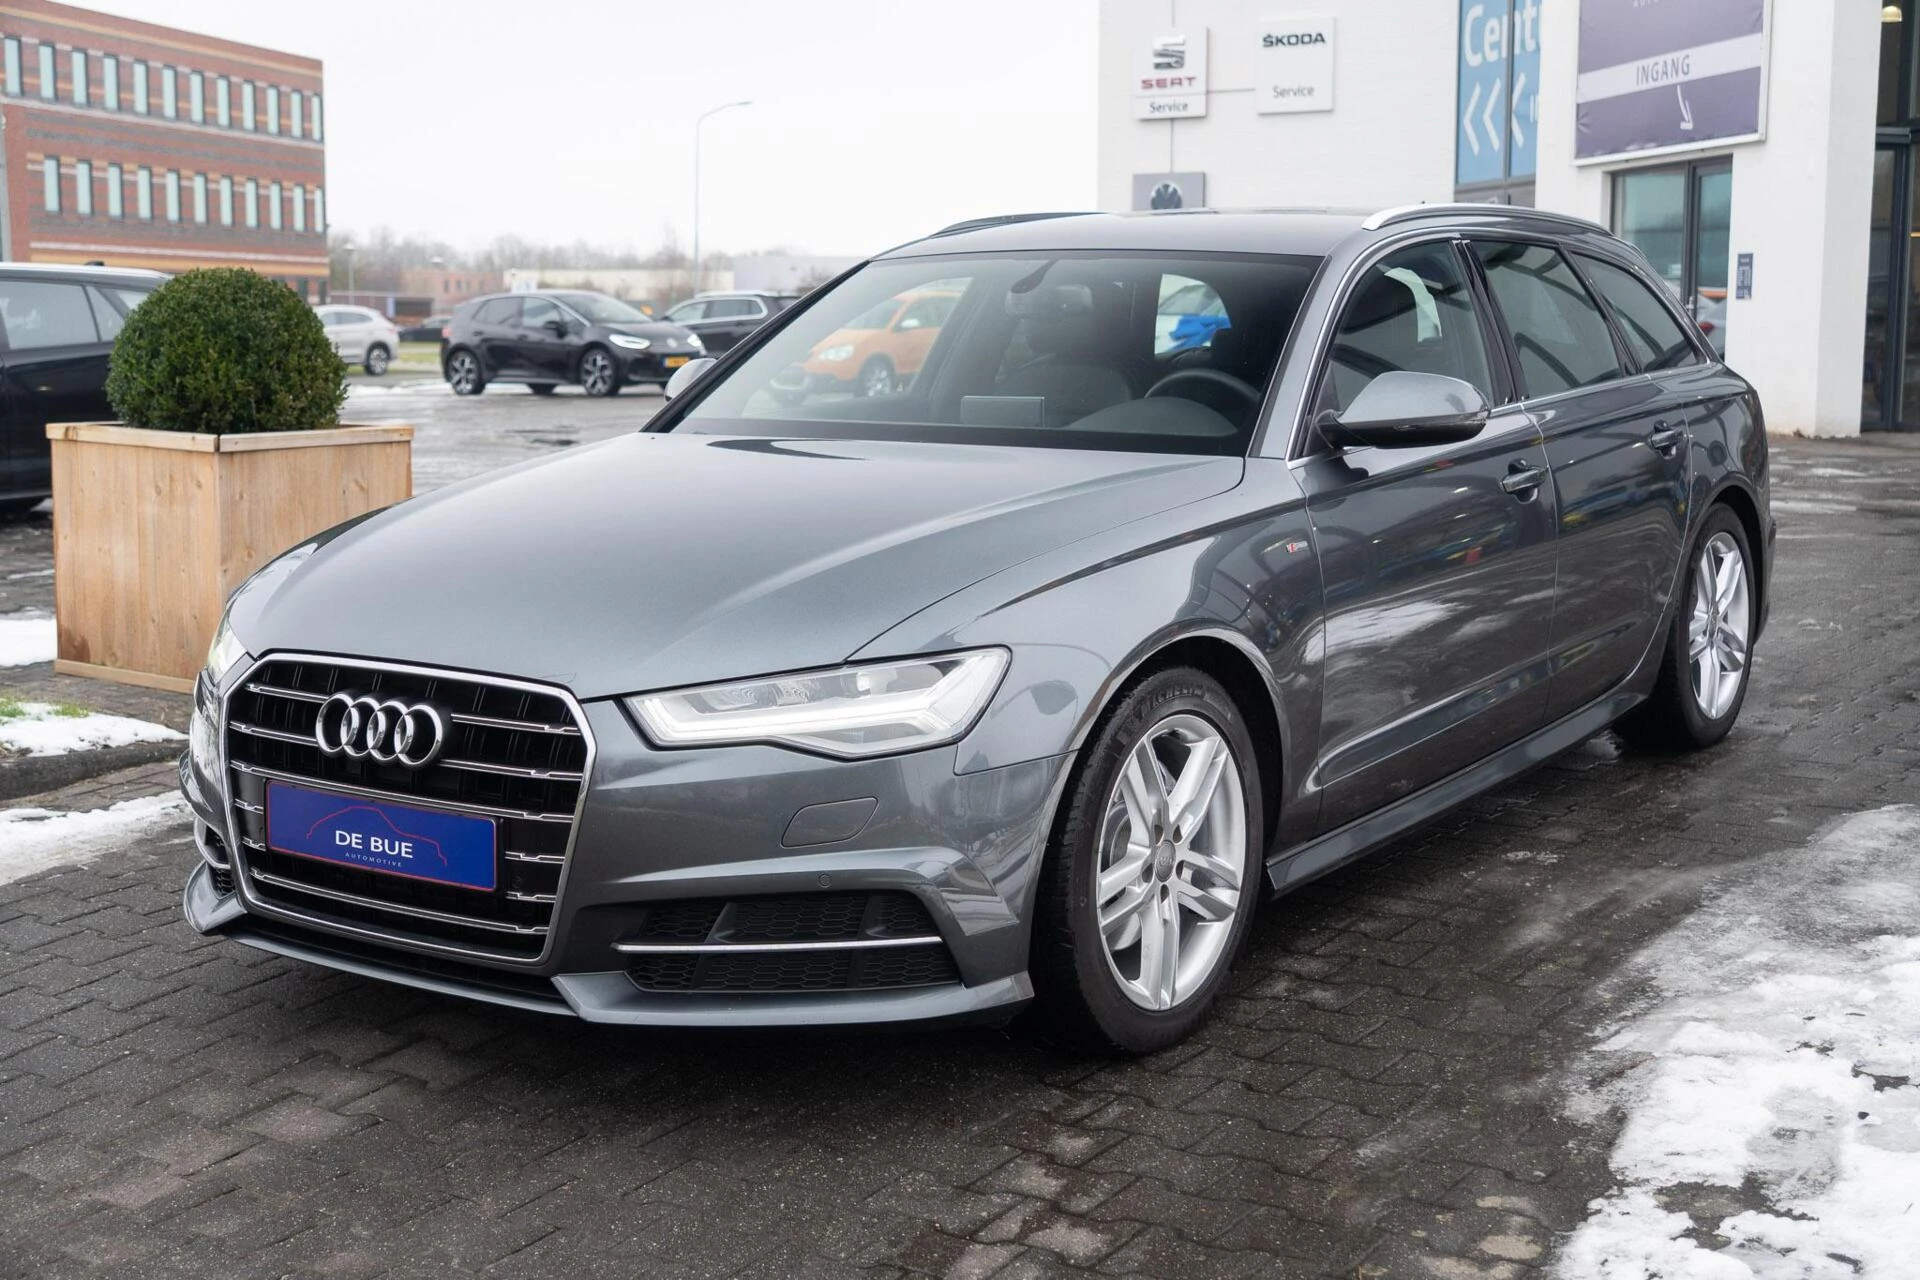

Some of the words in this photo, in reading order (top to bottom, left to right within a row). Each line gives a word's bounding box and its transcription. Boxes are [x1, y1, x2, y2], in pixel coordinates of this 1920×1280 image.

[1263, 32, 1326, 48] ŠKODA
[1464, 0, 1541, 67] Cent
[1635, 53, 1691, 86] INGANG
[1141, 76, 1197, 90] SEAT
[1273, 83, 1315, 98] Service
[1149, 99, 1189, 114] Service
[335, 829, 363, 849] DE
[370, 836, 414, 858] BUE
[345, 851, 402, 867] AUTOMOTIVE
